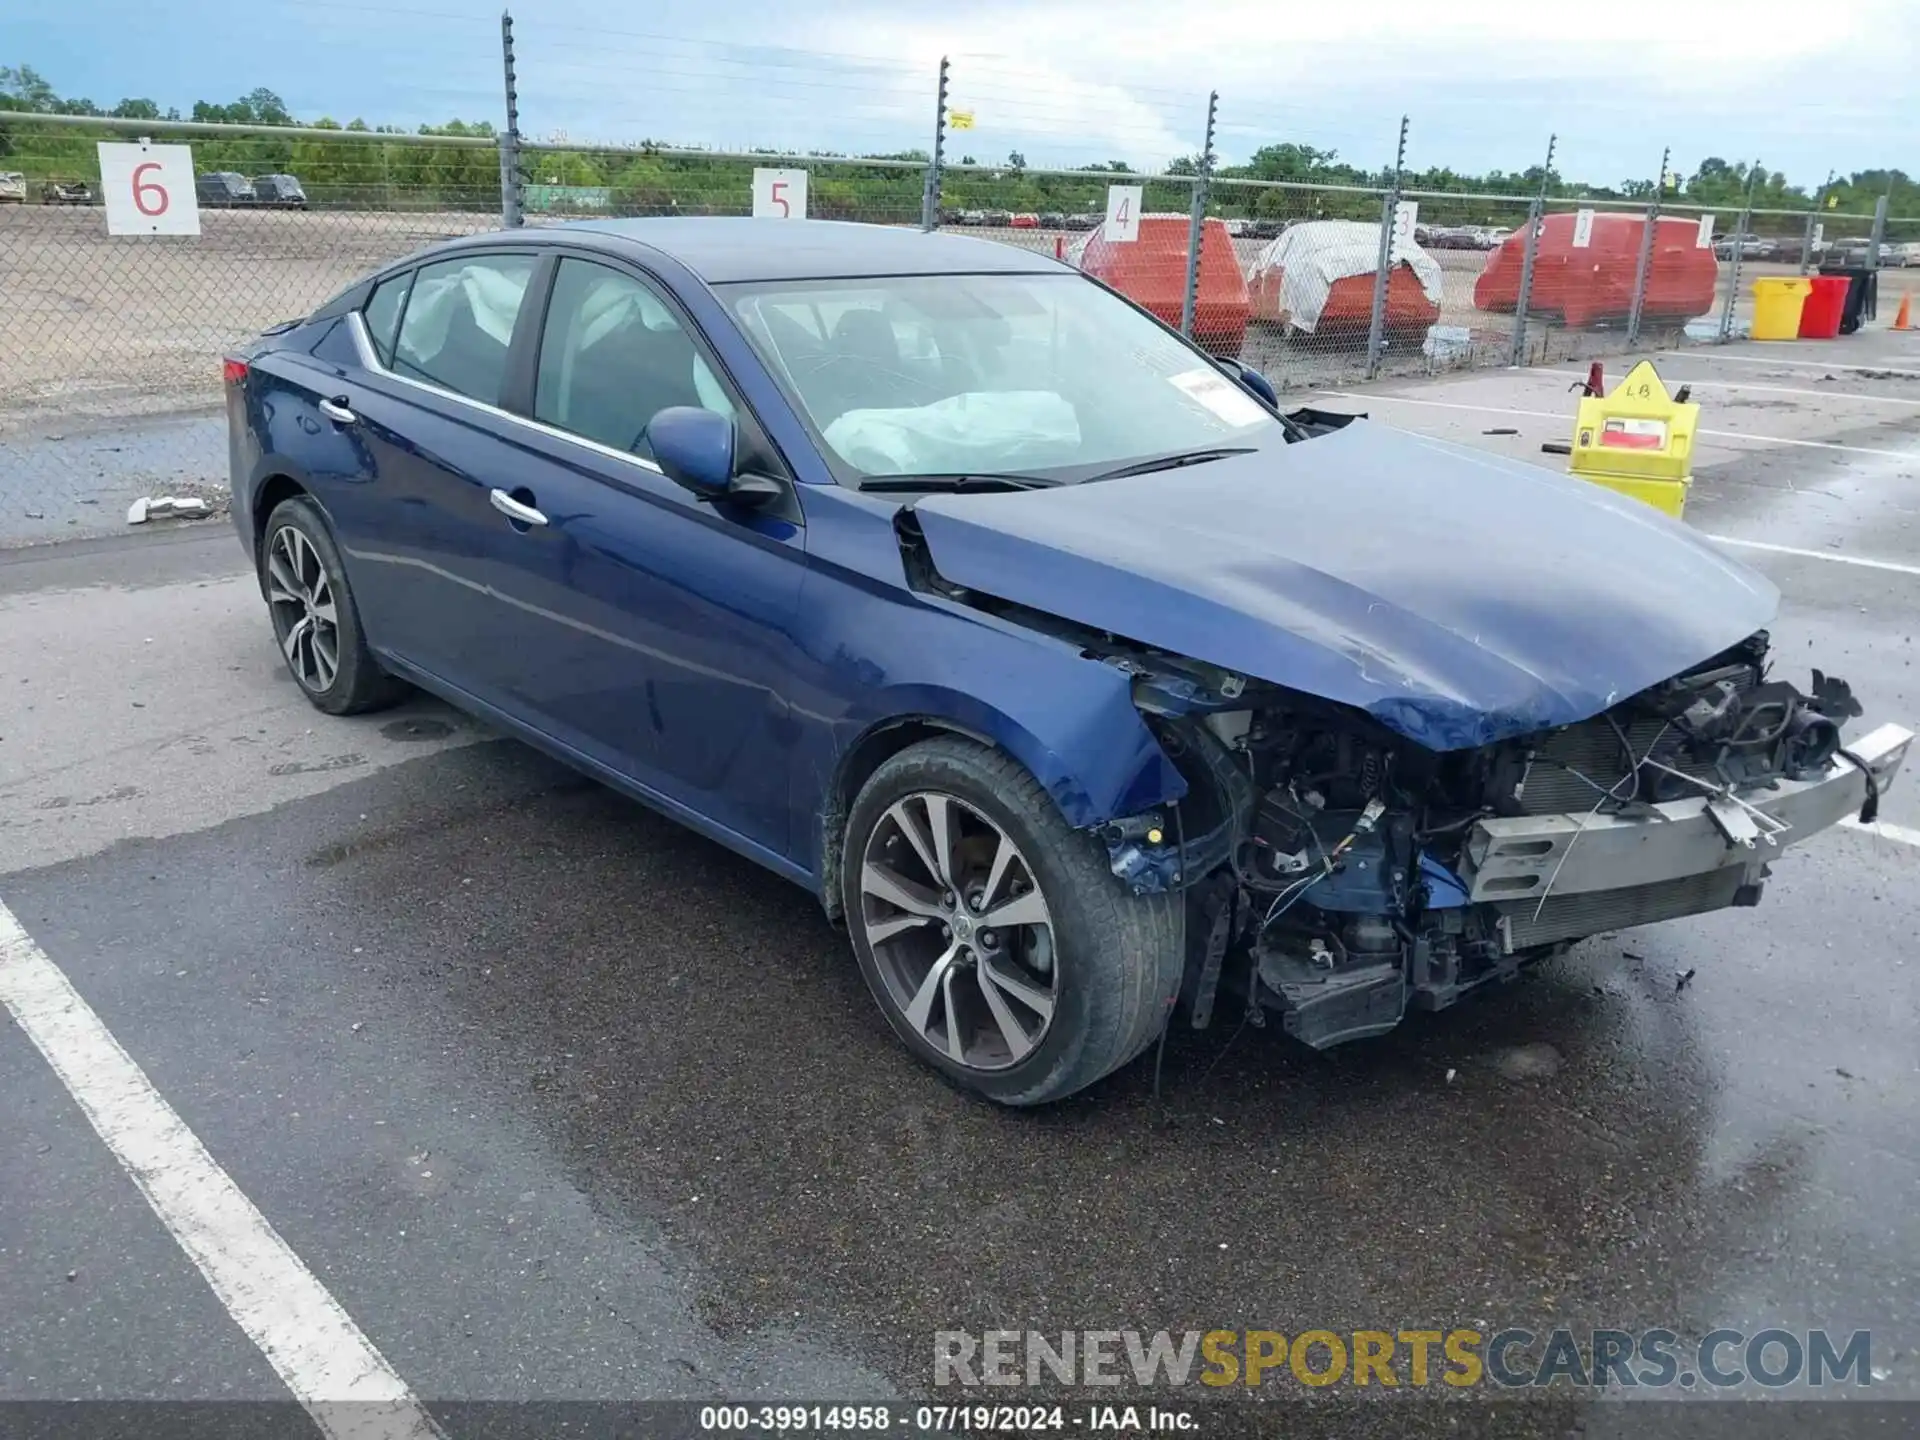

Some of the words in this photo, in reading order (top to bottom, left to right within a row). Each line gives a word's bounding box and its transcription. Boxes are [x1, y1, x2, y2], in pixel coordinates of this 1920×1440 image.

[132, 163, 169, 217] 6
[772, 183, 790, 219] 5
[1115, 197, 1130, 229] 4
[1399, 210, 1409, 236] 3
[1579, 215, 1588, 240] 2
